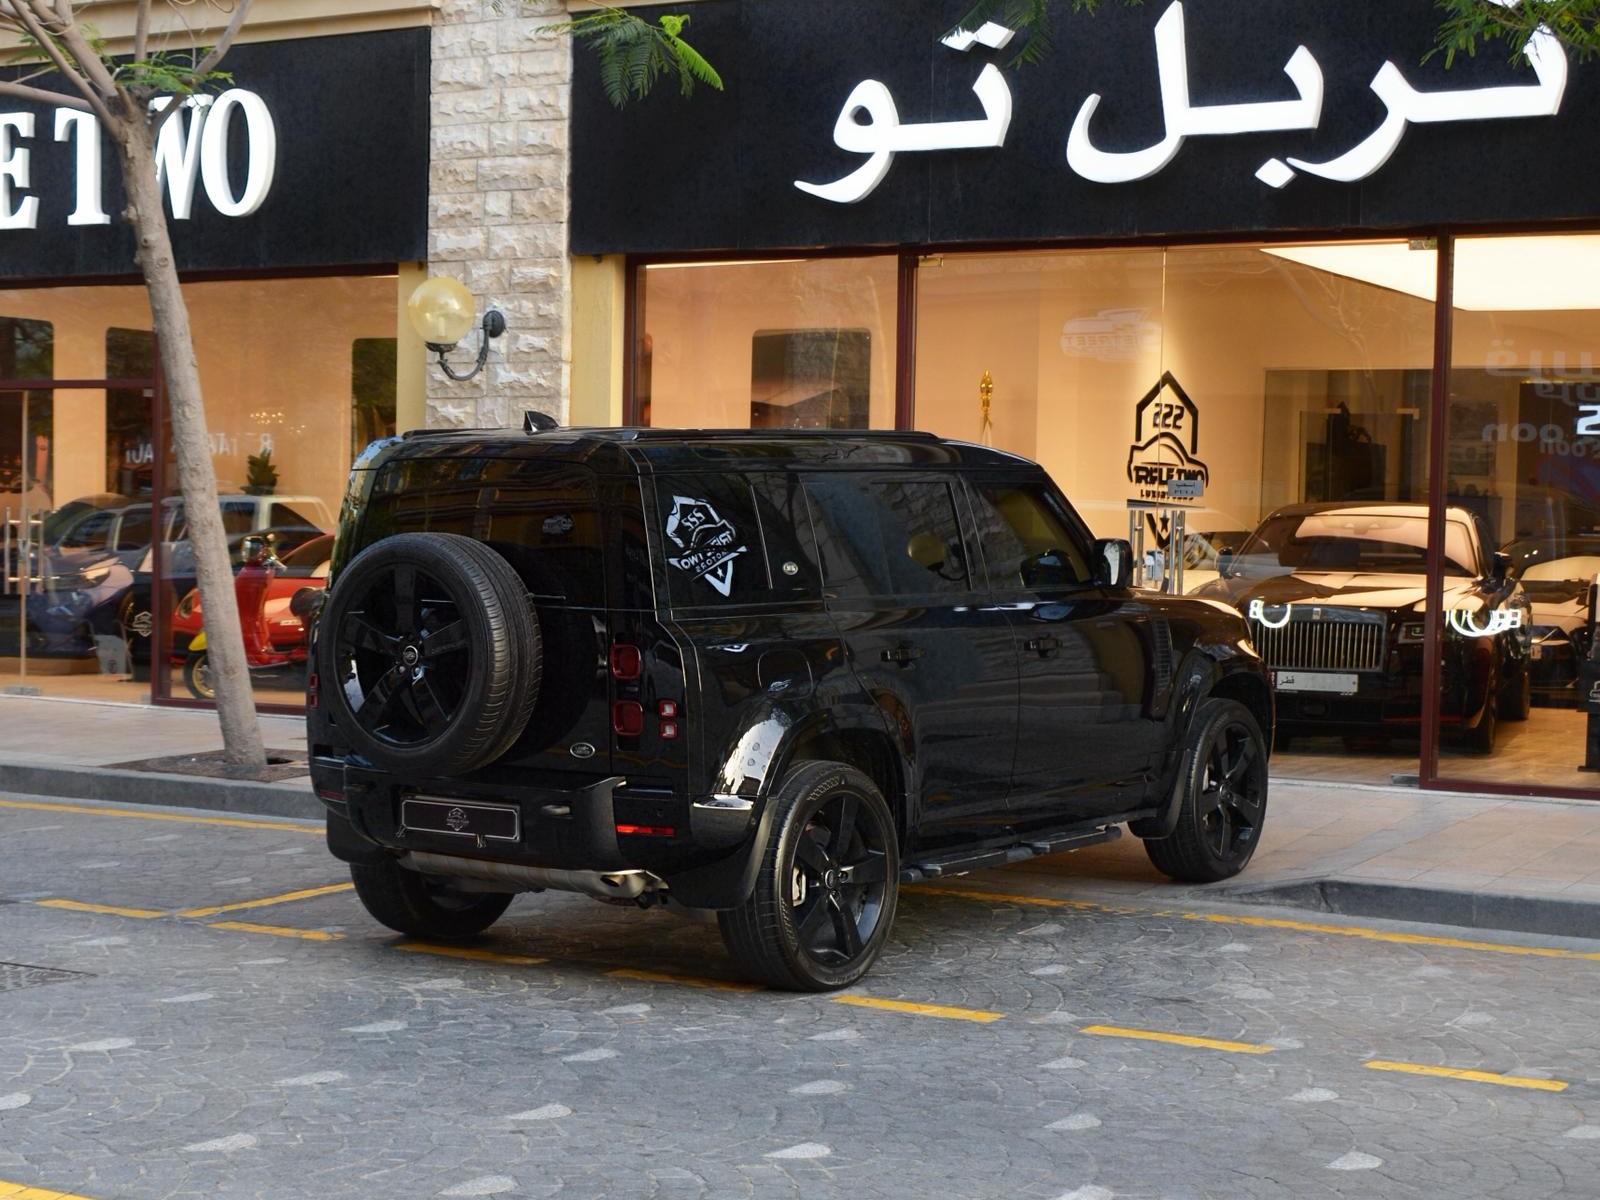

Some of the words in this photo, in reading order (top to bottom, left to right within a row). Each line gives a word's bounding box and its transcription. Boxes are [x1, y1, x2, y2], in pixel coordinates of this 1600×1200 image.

[54, 88, 277, 227] TWO
[794, 21, 1014, 204] تو
[1153, 403, 1185, 430] 222
